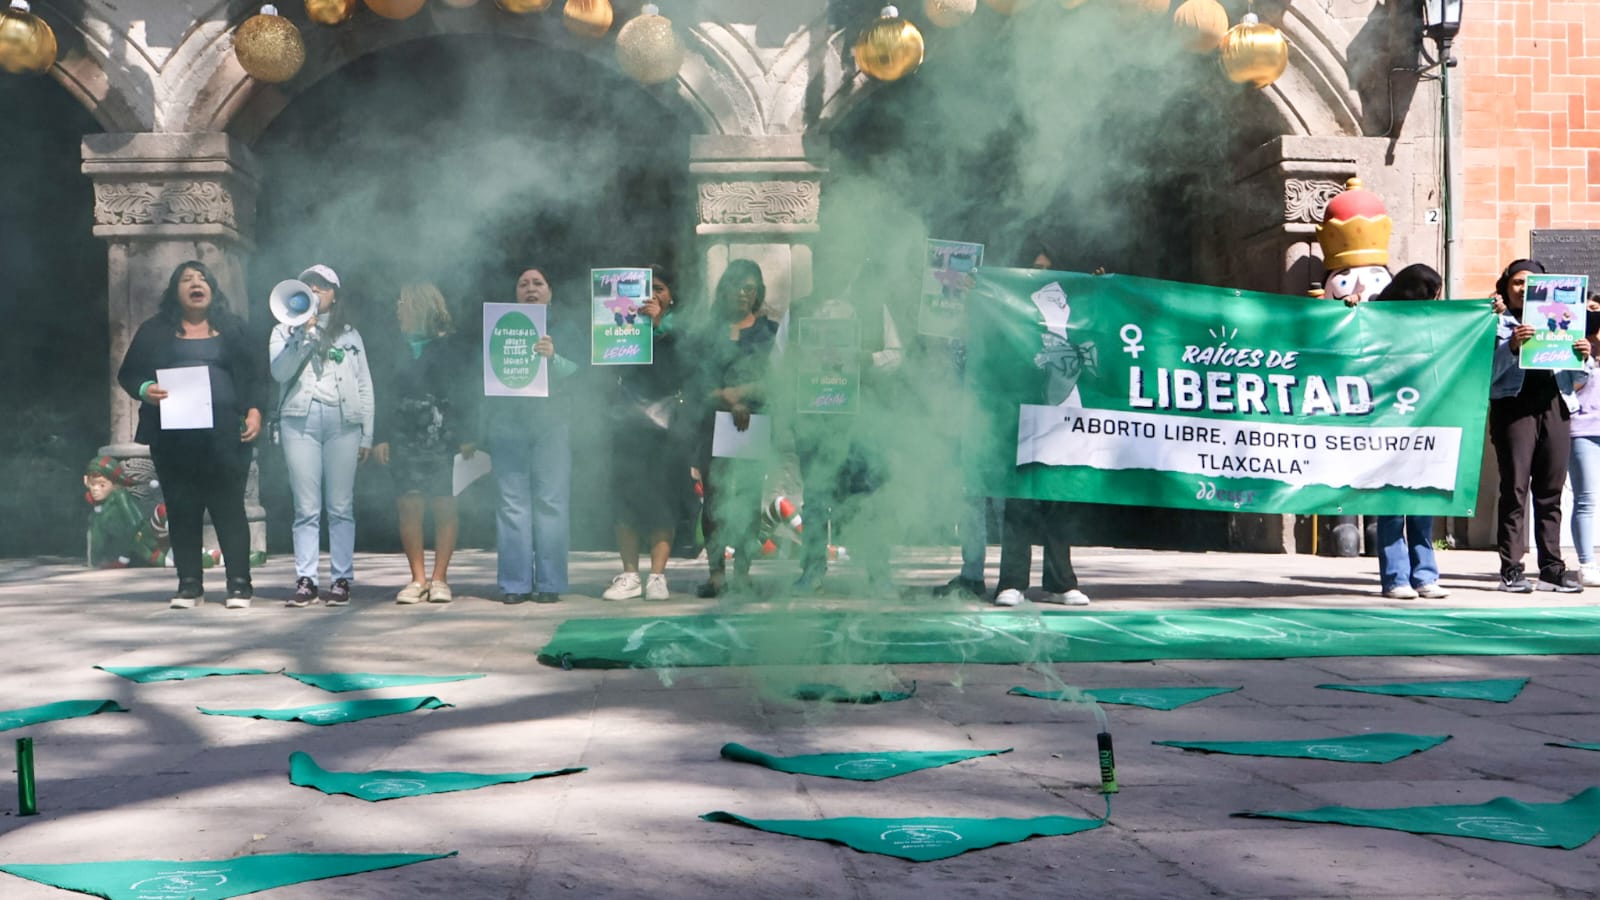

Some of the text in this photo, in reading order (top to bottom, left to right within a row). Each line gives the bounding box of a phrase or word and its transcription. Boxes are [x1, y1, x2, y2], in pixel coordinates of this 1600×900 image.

[1429, 210, 1437, 222] 2
[614, 327, 641, 337] aborto
[1546, 332, 1574, 342] aborto
[1181, 342, 1299, 370] RAÍCES DE
[1129, 366, 1375, 416] LIBERTAD
[1064, 416, 1155, 439] "ABORTO
[1234, 430, 1317, 450] ABORTO
[1325, 435, 1410, 451] SEGURO
[1413, 436, 1436, 451] EN
[1198, 453, 1310, 475] TLAXCALA"
